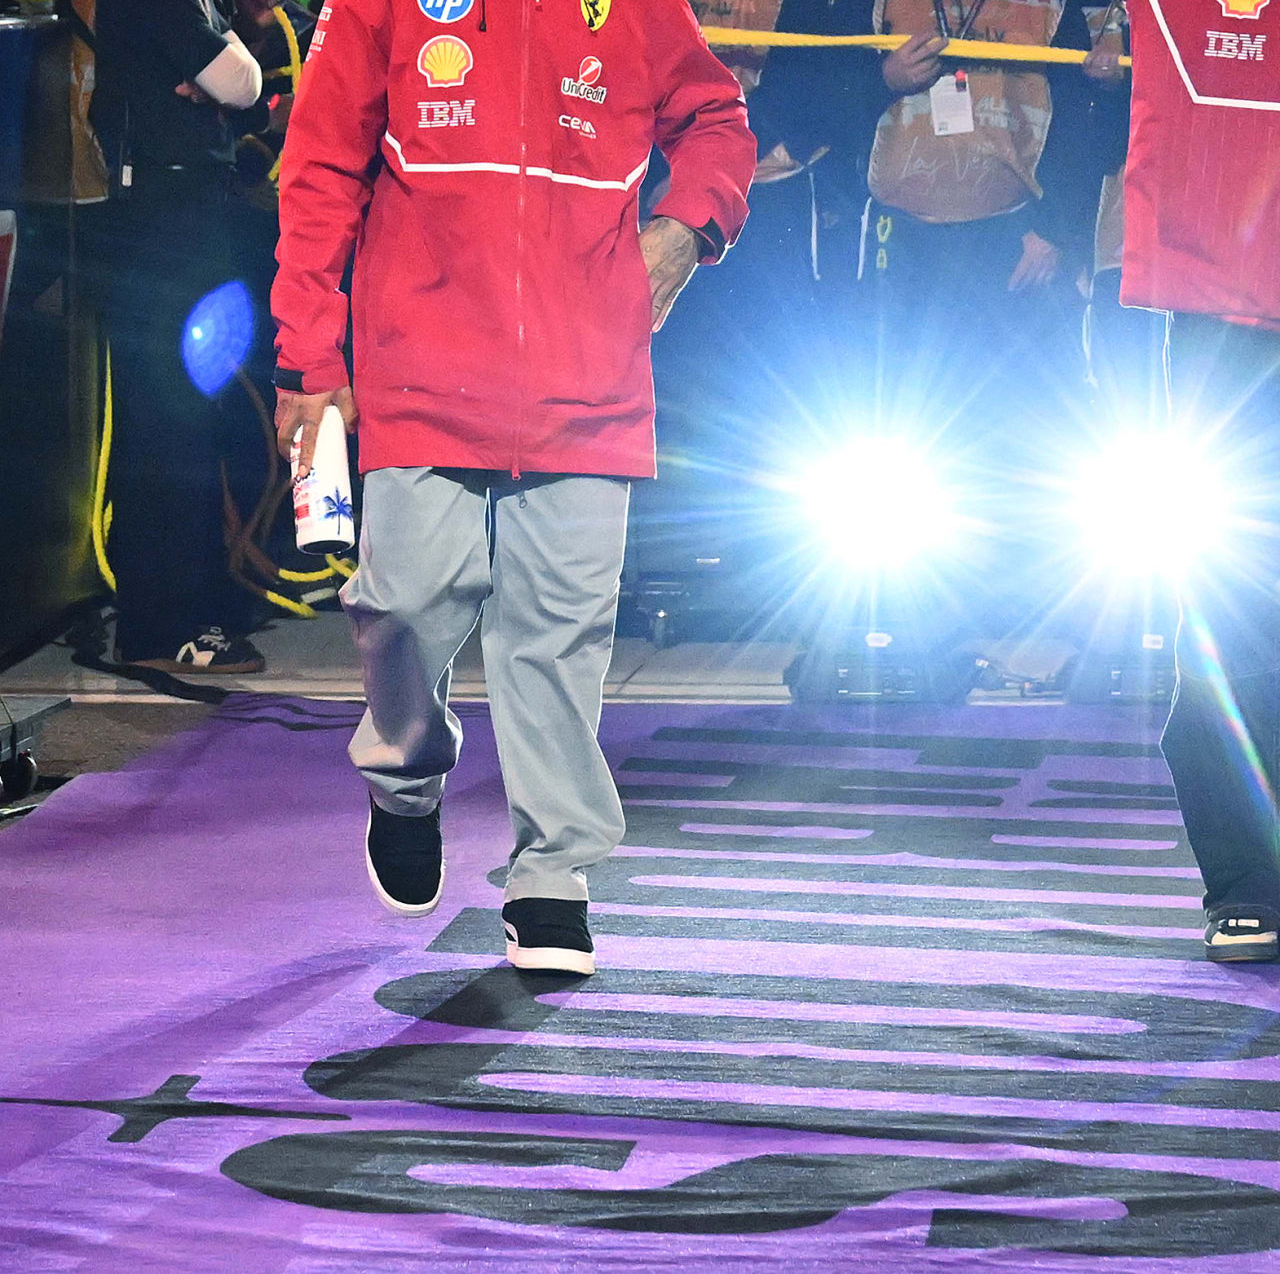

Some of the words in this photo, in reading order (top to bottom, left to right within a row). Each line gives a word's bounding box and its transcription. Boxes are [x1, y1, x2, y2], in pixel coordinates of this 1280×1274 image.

[1204, 30, 1267, 61] IBM
[561, 77, 608, 104] UniCredit
[417, 99, 476, 128] IBM
